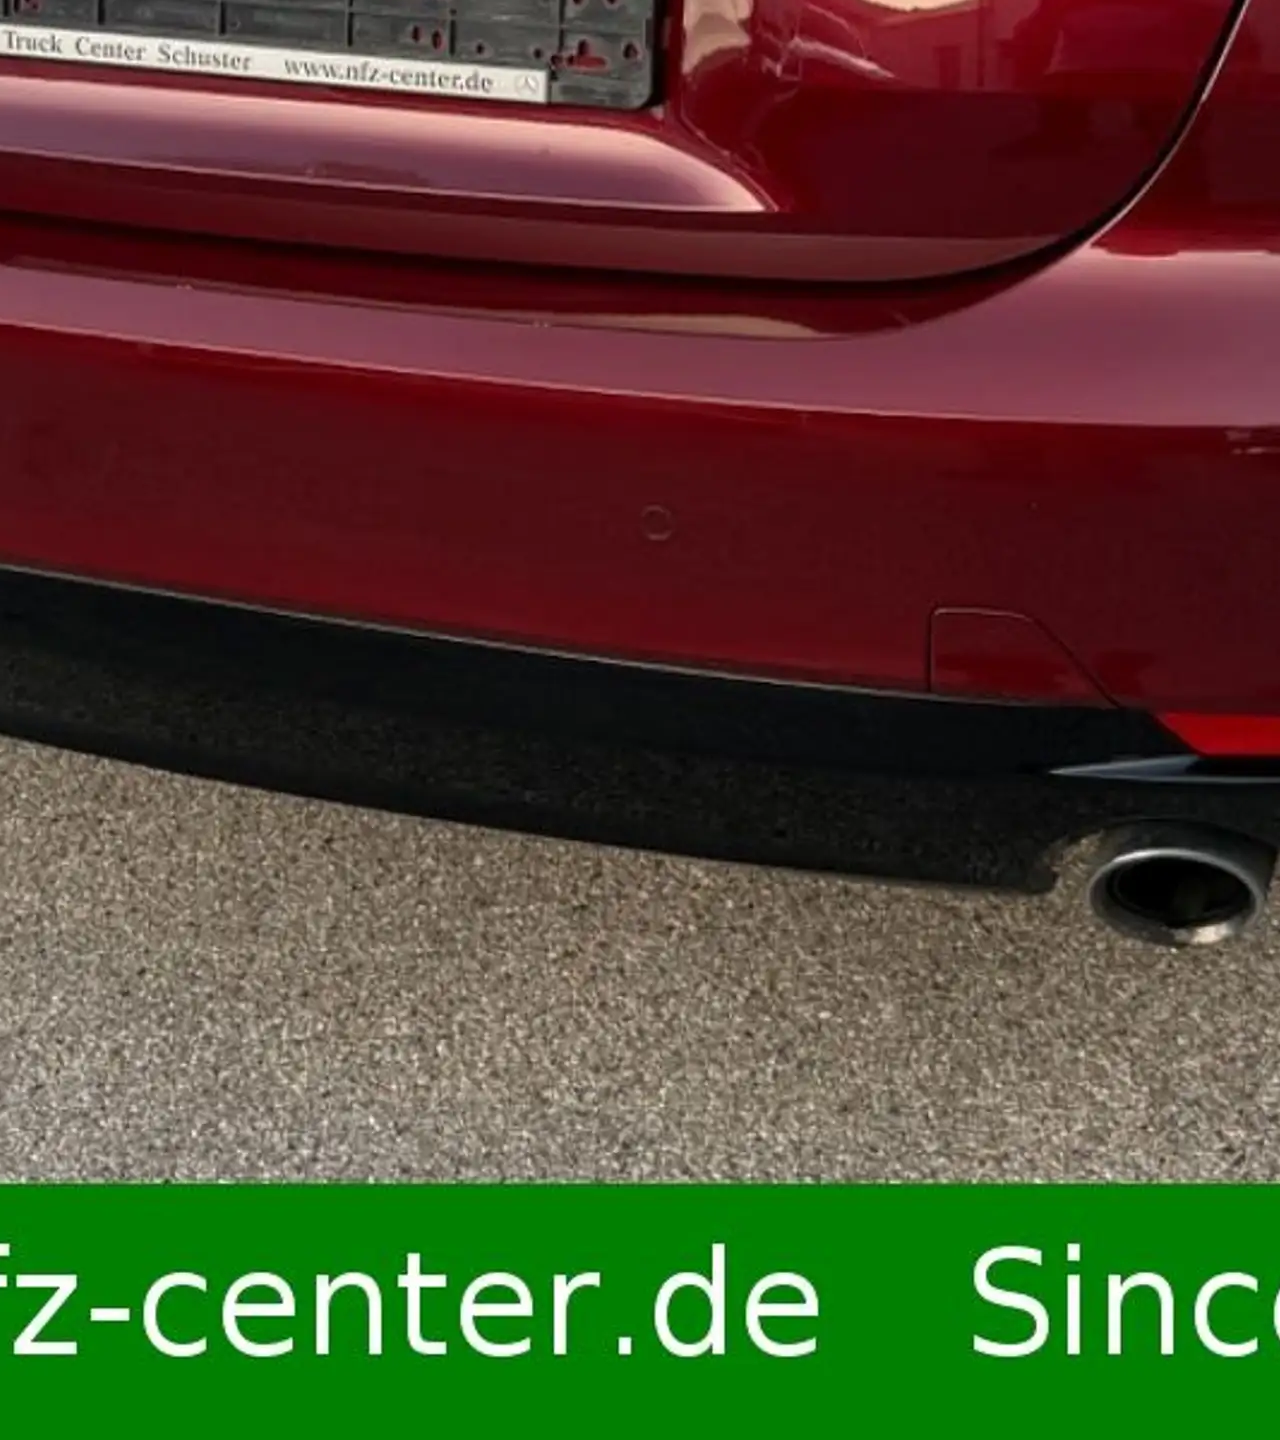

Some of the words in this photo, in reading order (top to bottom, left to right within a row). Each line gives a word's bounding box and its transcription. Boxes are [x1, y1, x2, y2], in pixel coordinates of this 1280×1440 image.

[3, 29, 62, 54] Truck
[75, 35, 148, 62] Center
[157, 43, 252, 72] Schuster
[284, 58, 495, 94] www.nfz-center.de
